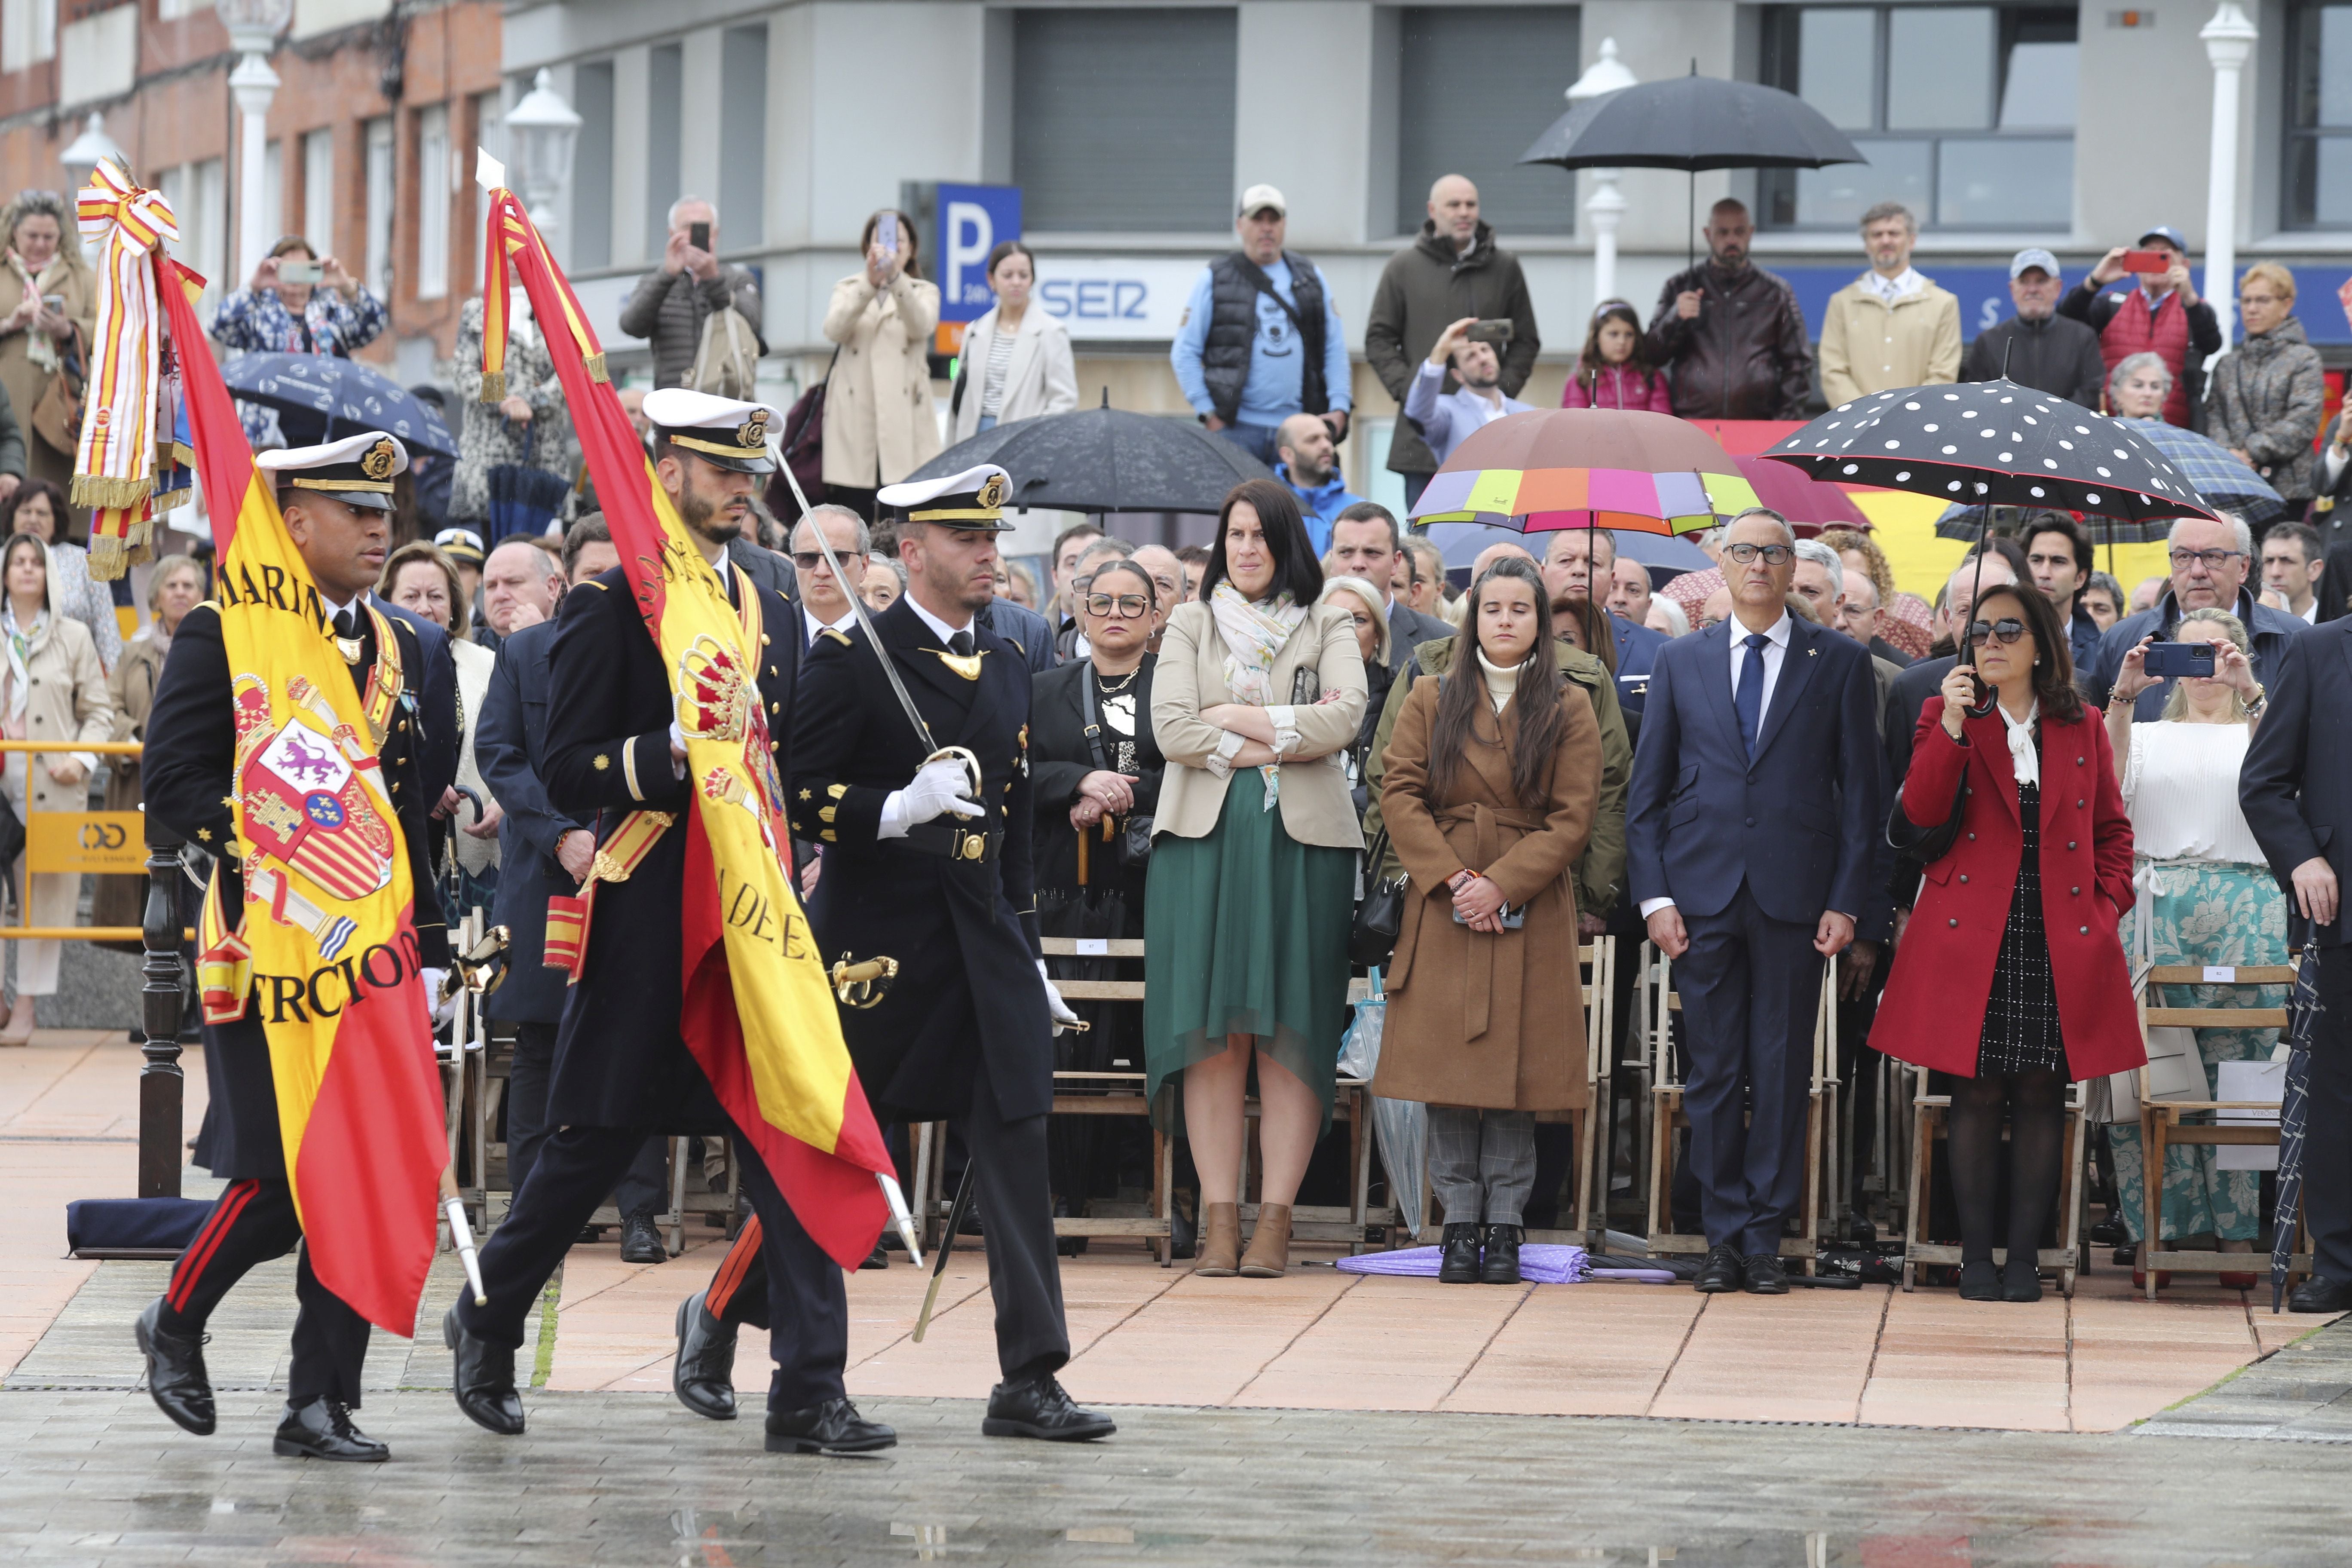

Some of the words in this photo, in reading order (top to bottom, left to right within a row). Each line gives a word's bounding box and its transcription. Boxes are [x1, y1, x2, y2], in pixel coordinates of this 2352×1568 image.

[1040, 279, 1148, 318] SER
[1978, 297, 2001, 330] S
[219, 561, 337, 643] MARIN
